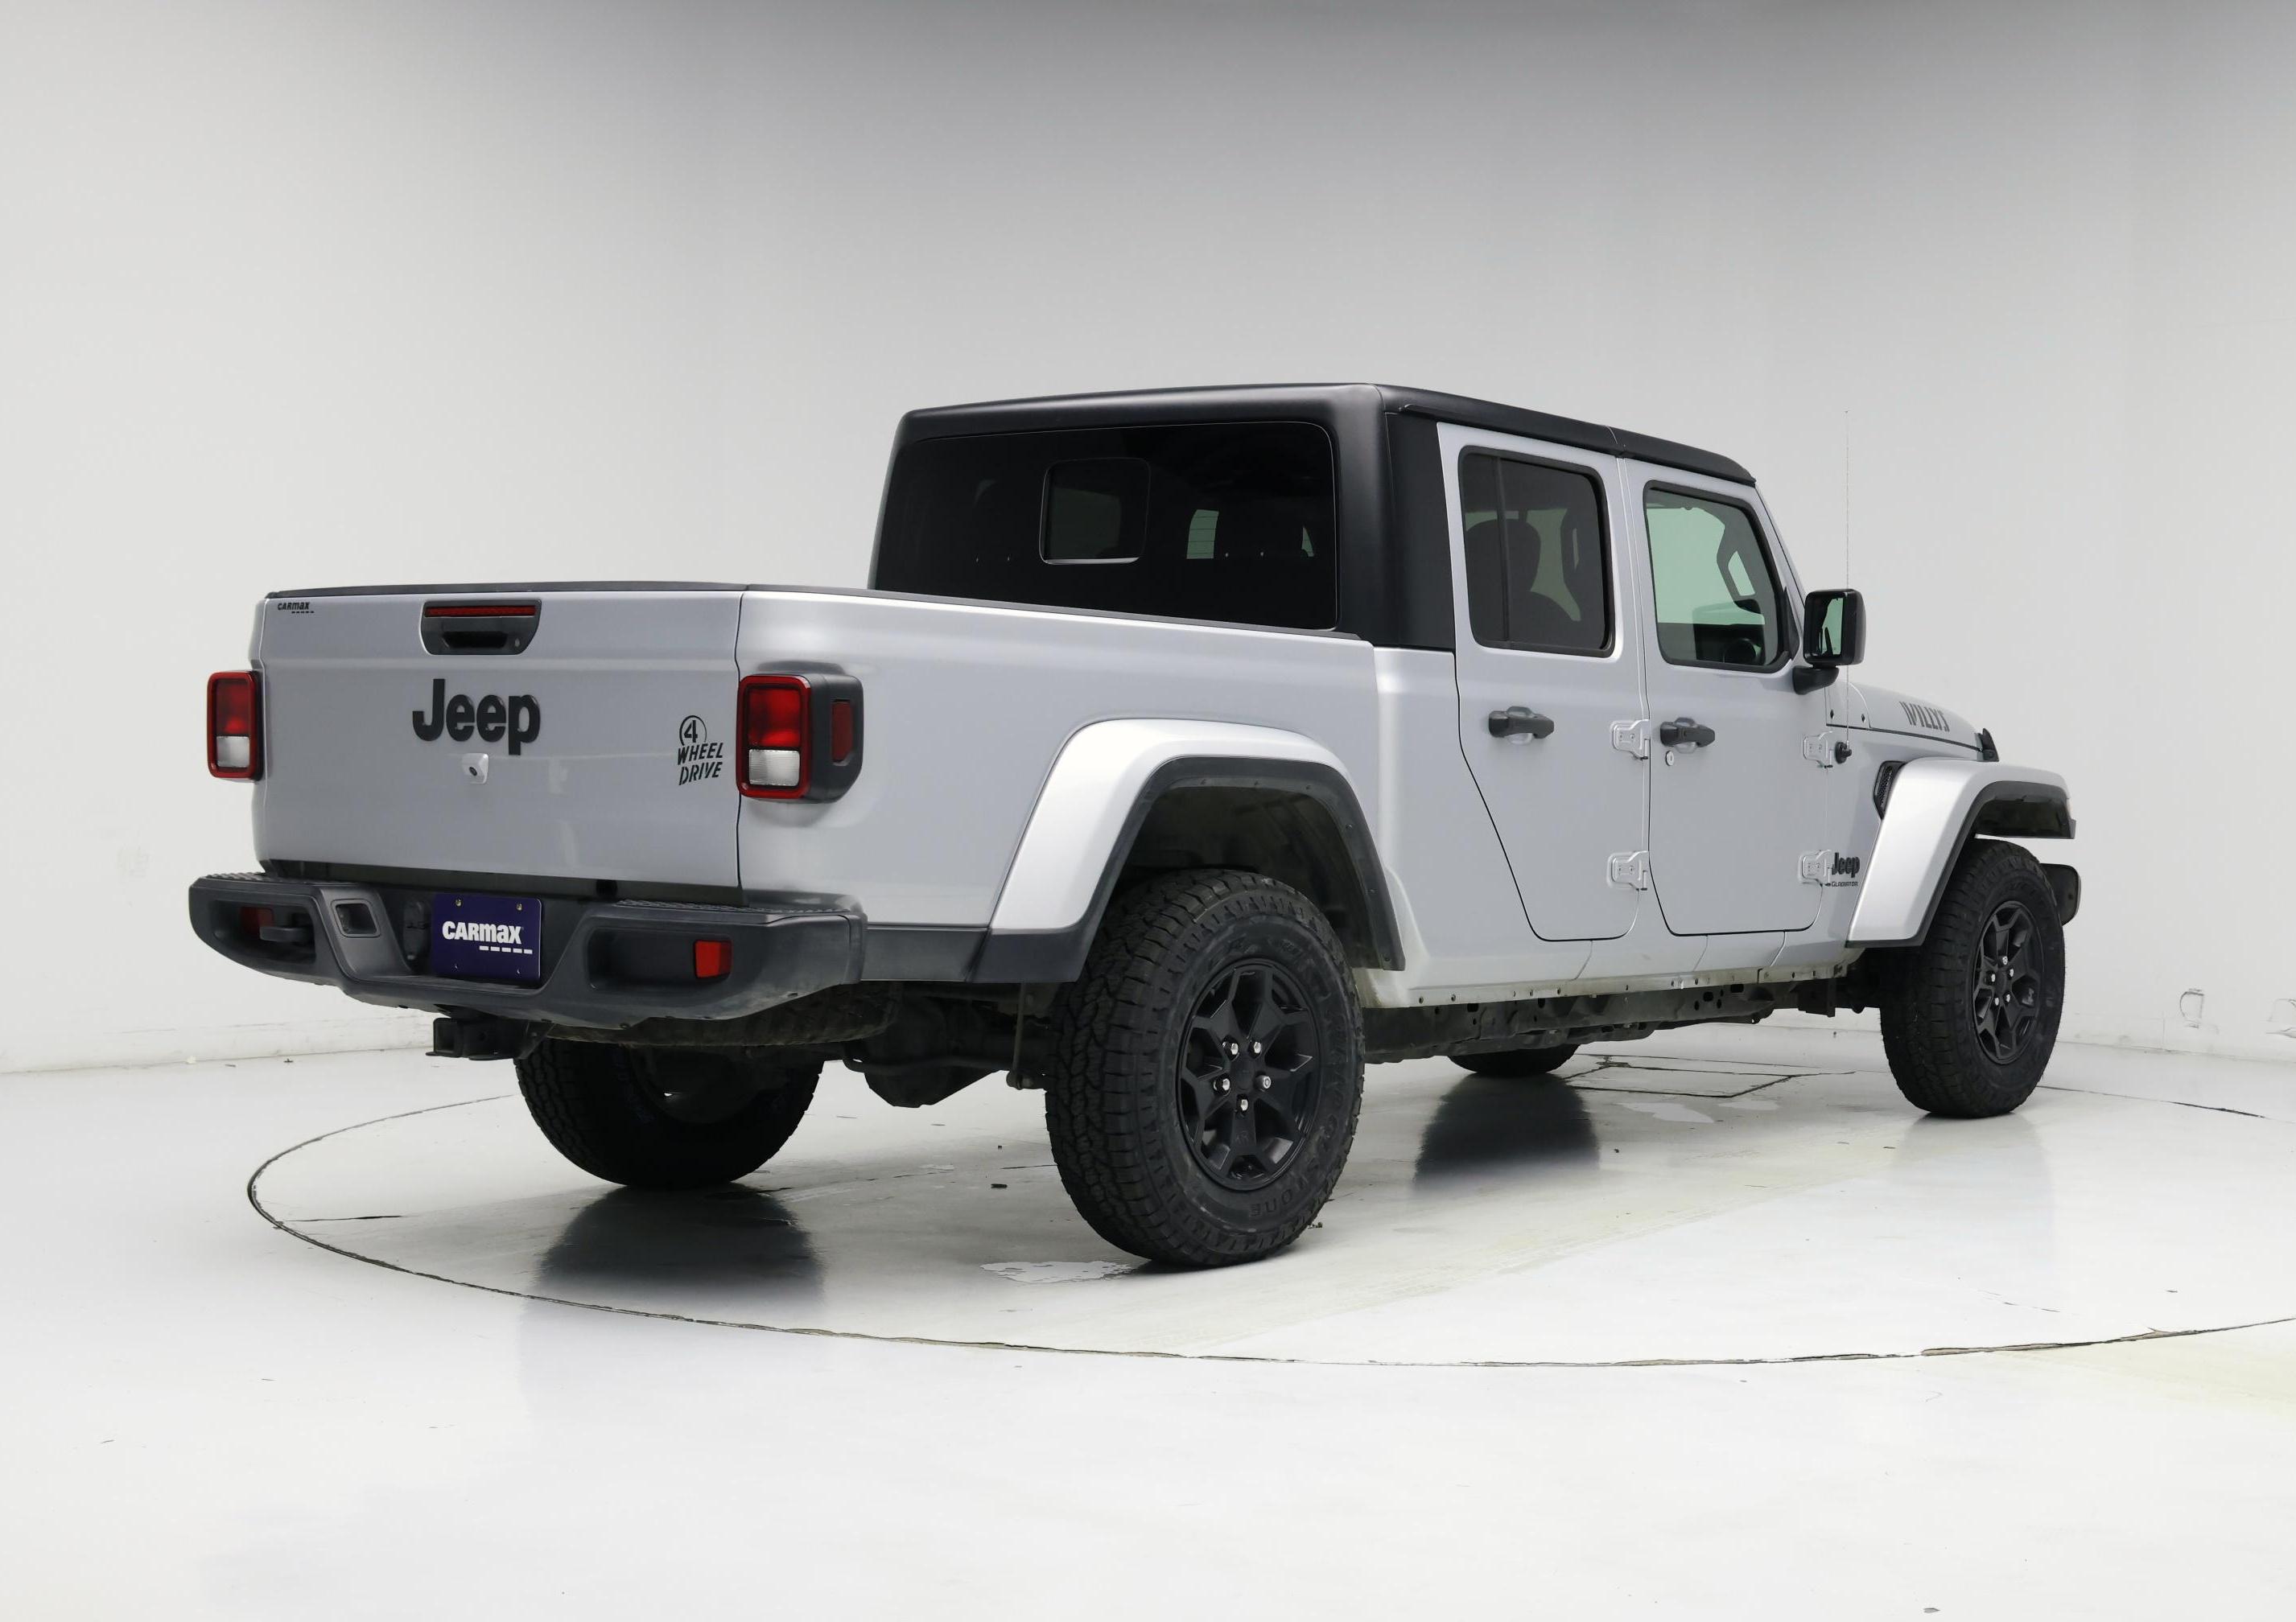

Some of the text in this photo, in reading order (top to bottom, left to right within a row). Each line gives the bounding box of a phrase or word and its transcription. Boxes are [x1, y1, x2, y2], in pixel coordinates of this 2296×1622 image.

[412, 678, 541, 755] Jeep
[1898, 701, 1950, 732] WILLYS
[683, 719, 698, 743] 4
[678, 743, 723, 765] WHEEL
[678, 762, 723, 785] DRIVE
[1832, 852, 1860, 878] Jeep
